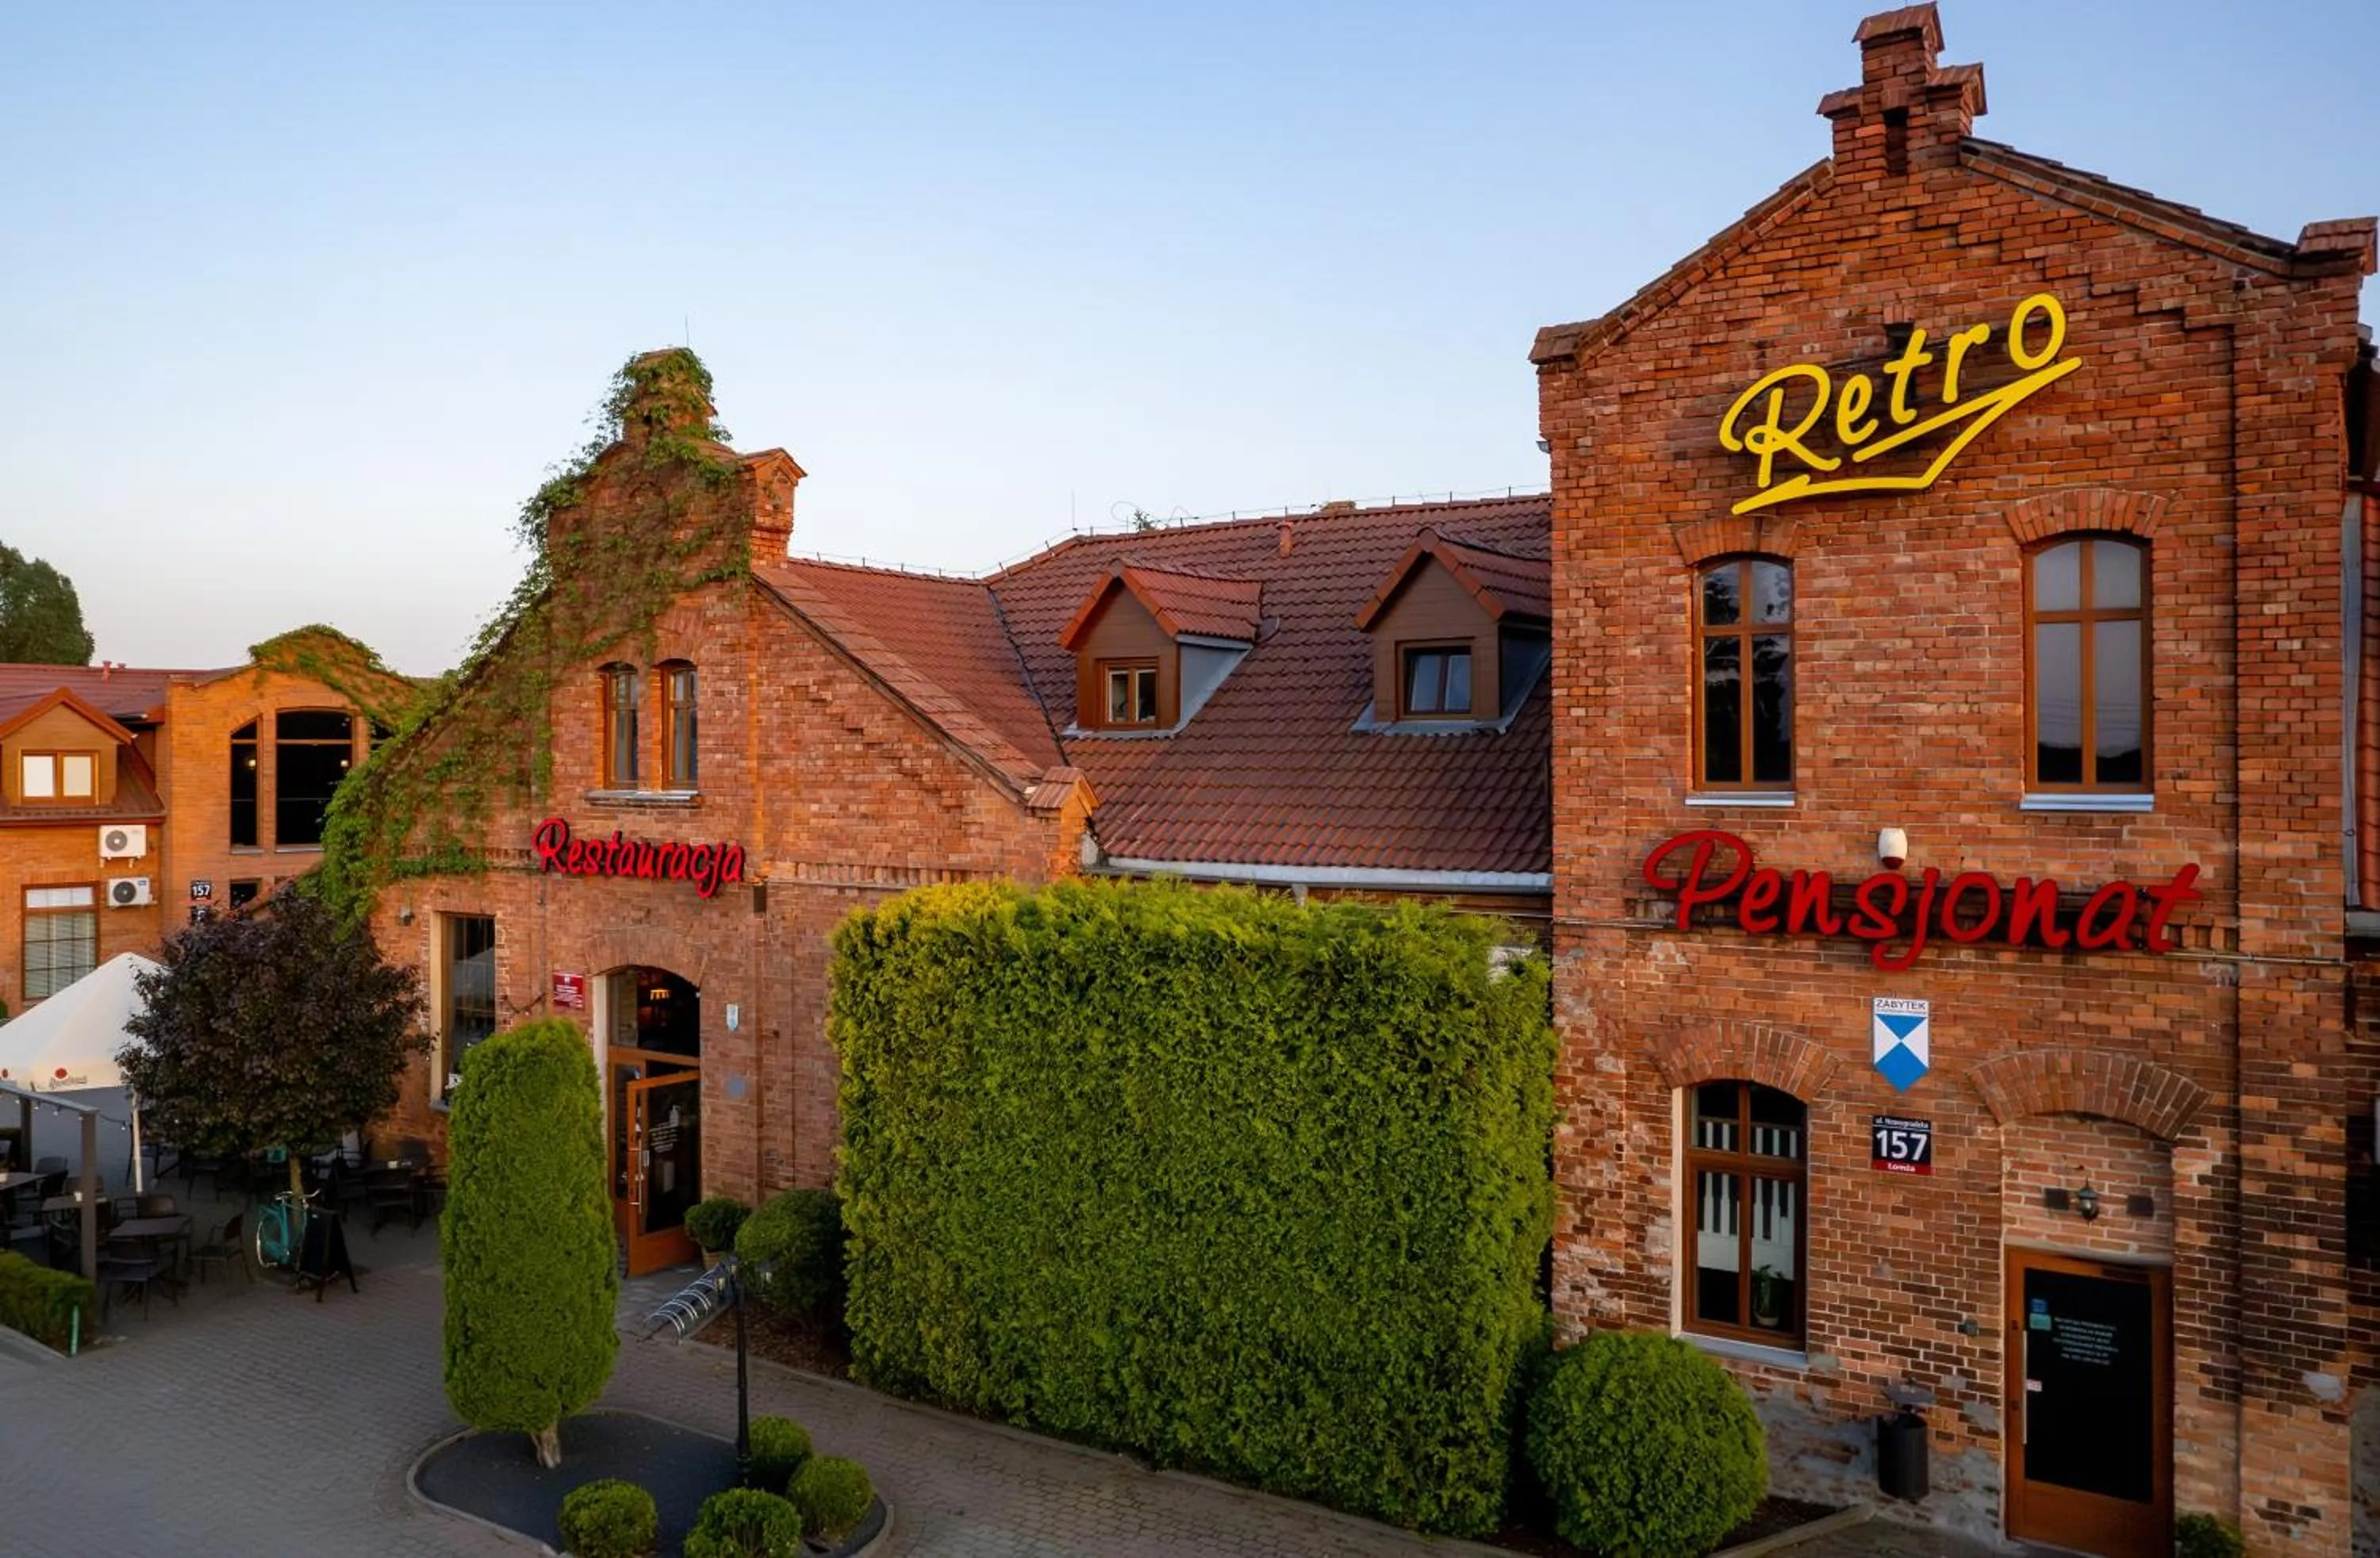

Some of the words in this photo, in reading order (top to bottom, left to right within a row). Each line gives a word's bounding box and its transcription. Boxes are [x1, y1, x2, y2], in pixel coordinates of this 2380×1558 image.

[1719, 293, 2067, 489] Retro
[532, 818, 746, 899] Restauracja
[193, 885, 210, 896] 157
[1642, 830, 2204, 971] Pensjonat
[1876, 1000, 1926, 1010] ZABYTEK
[1876, 1129, 1928, 1161] 157
